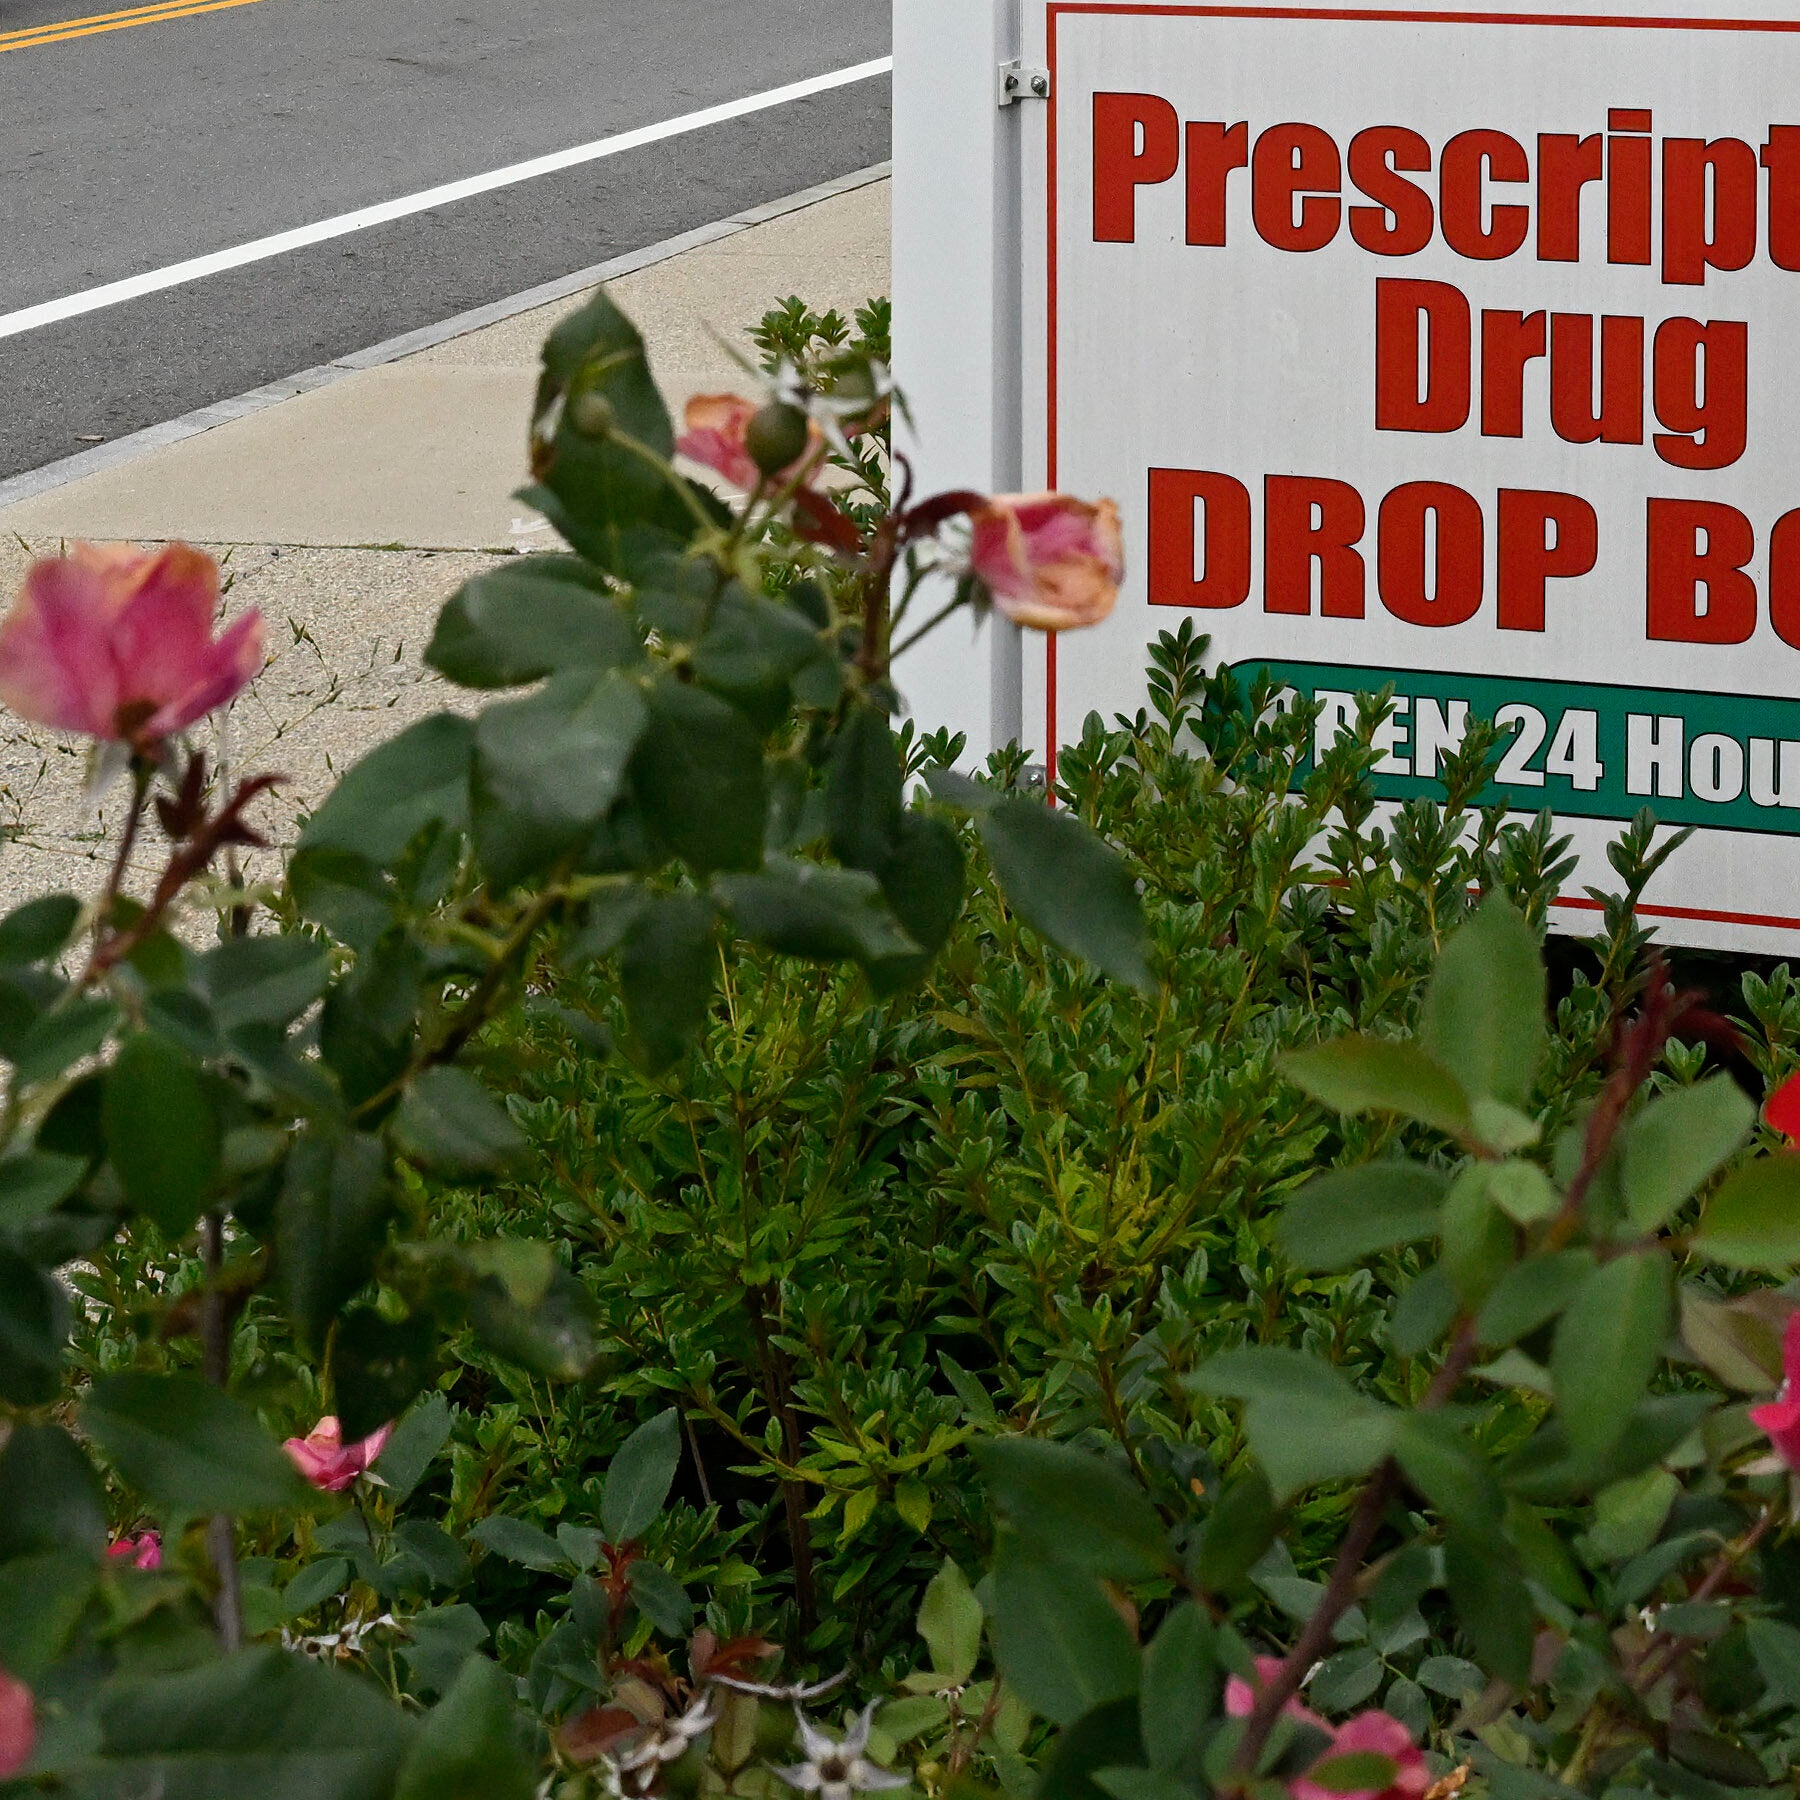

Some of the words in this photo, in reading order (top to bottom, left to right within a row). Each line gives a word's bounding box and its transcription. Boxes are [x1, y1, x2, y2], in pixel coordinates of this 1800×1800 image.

[1374, 276, 1749, 470] Drug
[1147, 466, 1599, 633] DROP
[1493, 703, 1603, 791] 24
